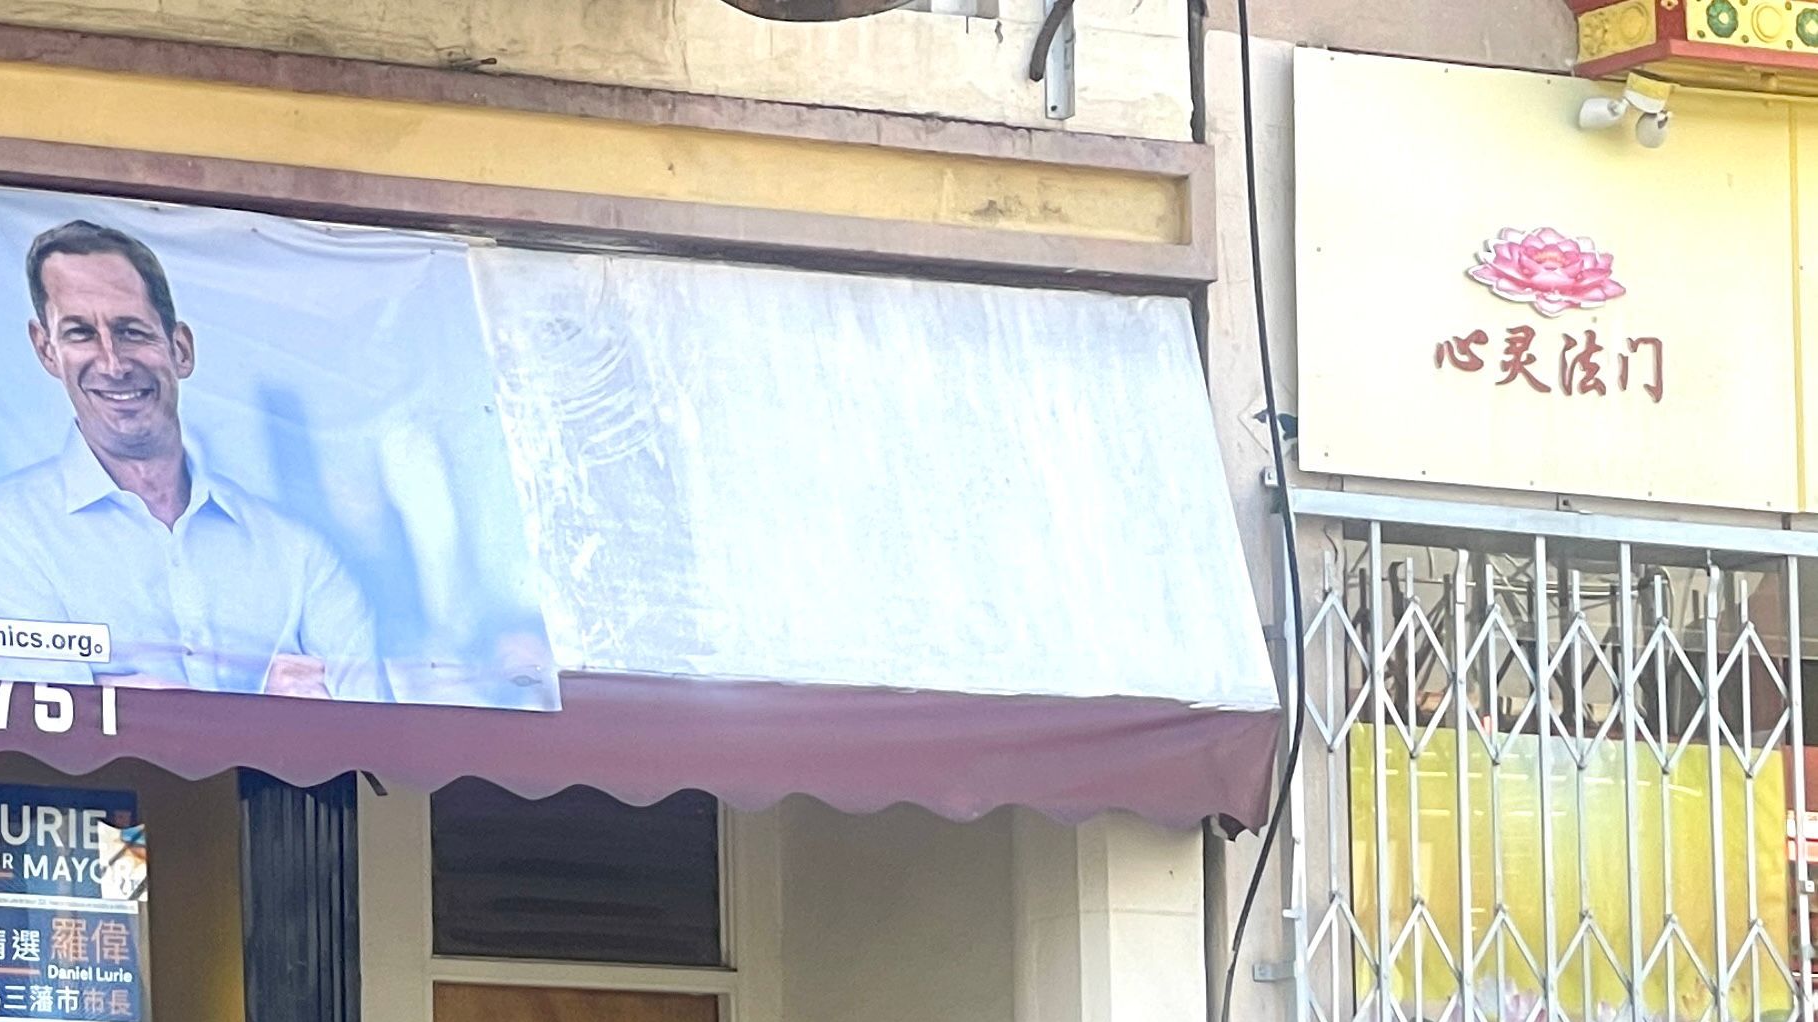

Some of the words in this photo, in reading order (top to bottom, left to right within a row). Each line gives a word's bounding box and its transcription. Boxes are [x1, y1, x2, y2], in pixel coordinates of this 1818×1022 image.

[1434, 324, 1665, 403] 心灵法门
[51, 918, 130, 965] 羅偉
[48, 965, 92, 981] Daniel
[96, 967, 132, 983] Lurie
